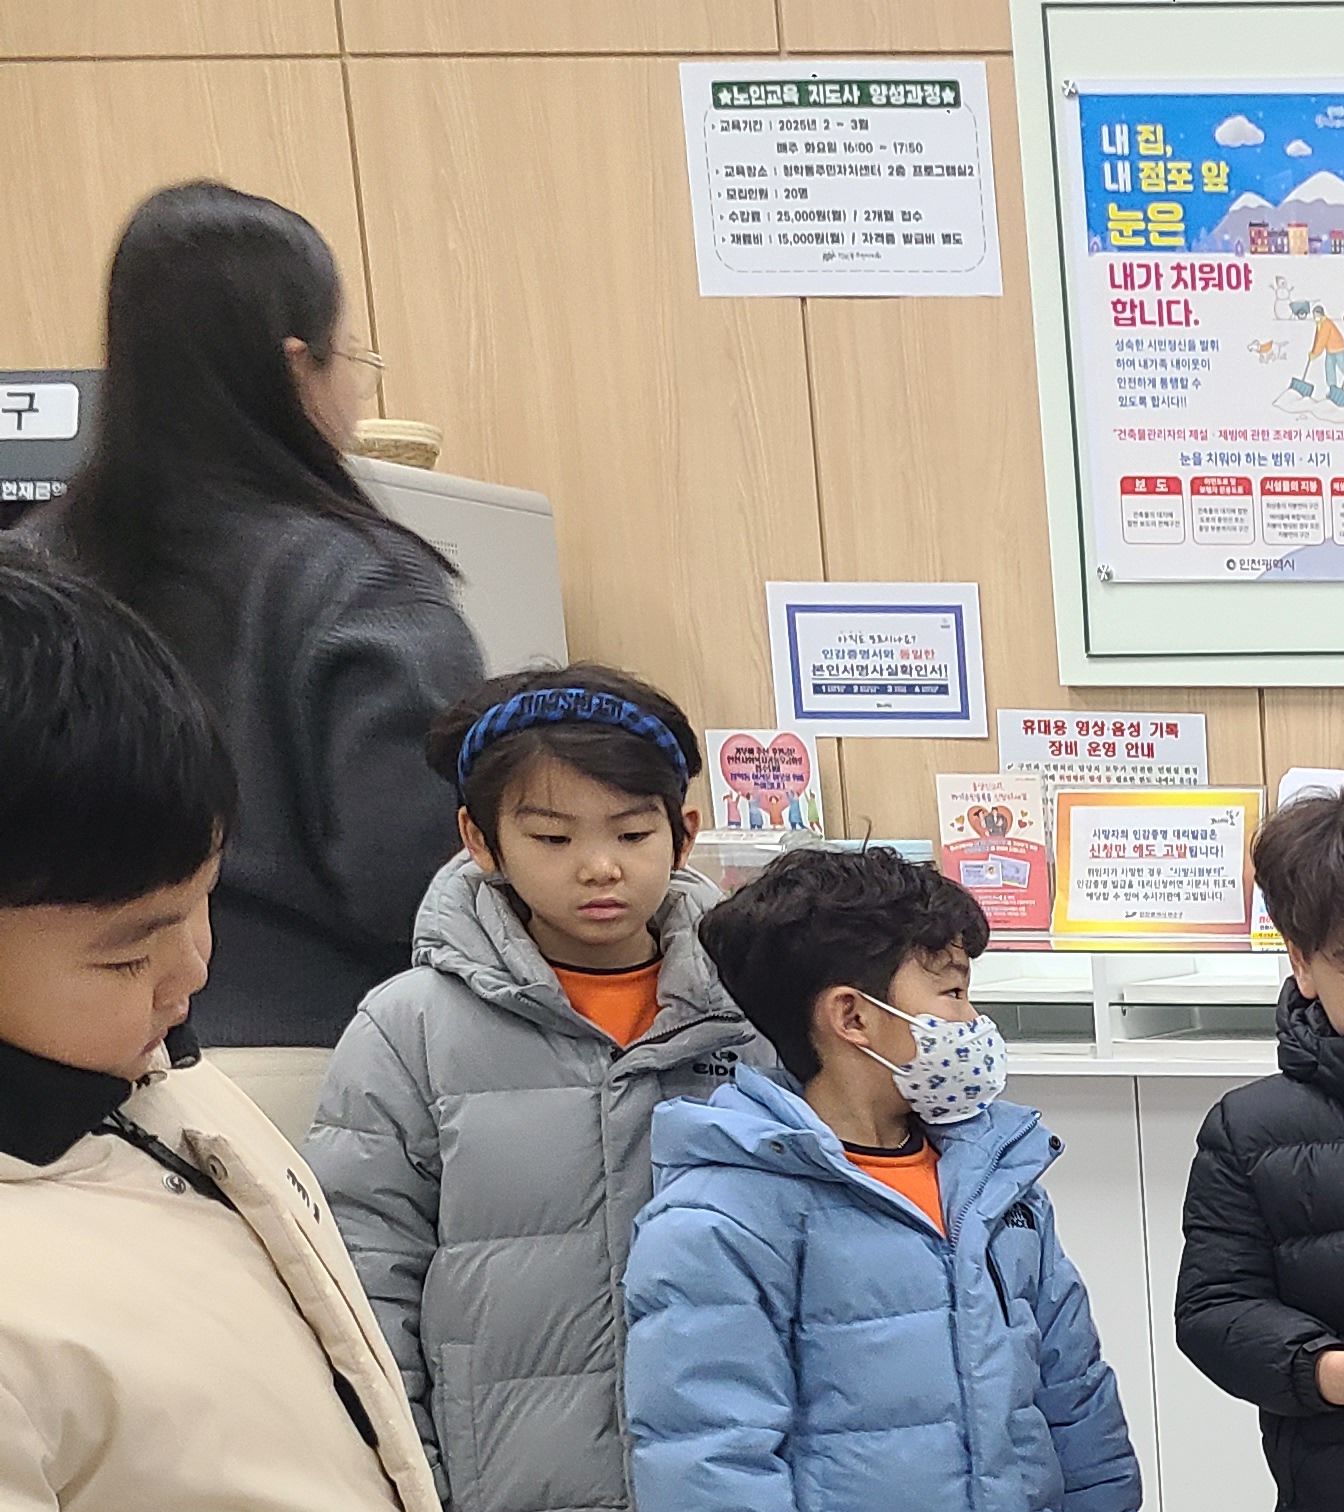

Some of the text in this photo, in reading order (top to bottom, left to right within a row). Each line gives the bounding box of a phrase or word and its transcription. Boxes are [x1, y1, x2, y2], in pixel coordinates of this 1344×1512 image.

[734, 84, 941, 105] 노인교육 지도사 양성과정
[720, 120, 763, 133] 교육기간
[778, 120, 817, 131] 2025년
[823, 120, 830, 131] 2
[1101, 124, 1173, 157] 내 집,
[777, 141, 923, 154] 매주 화요일 16:00 17:50
[1103, 161, 1229, 193] 내 점포 앞
[1107, 202, 1185, 247] 눈은
[1109, 262, 1252, 292] 내가 치워야
[1111, 298, 1200, 327] 합니다.
[1115, 340, 1144, 352] 성숙한
[1148, 340, 1196, 352] 시민정신을
[1116, 358, 1210, 371] 하여 내가족 내이웃이
[1117, 377, 1156, 390] 안전하게
[1192, 377, 1201, 389] 수
[1118, 396, 1147, 408] 있도록
[1251, 430, 1270, 442] 관한
[1273, 429, 1302, 442] 조례가
[1306, 430, 1344, 442] 시행되고
[1180, 452, 1330, 467] 눈을 치워야 하는 범위 시기
[1239, 559, 1295, 571] 인천광역시
[1023, 720, 1067, 735] 휴대용
[1150, 722, 1179, 738] 기록
[1049, 741, 1154, 758] 장비 운영 안내
[1093, 829, 1217, 840] 사망자의 인감증명 대리발급은
[1089, 844, 1126, 858] 신청만
[1113, 892, 1120, 901] 수
